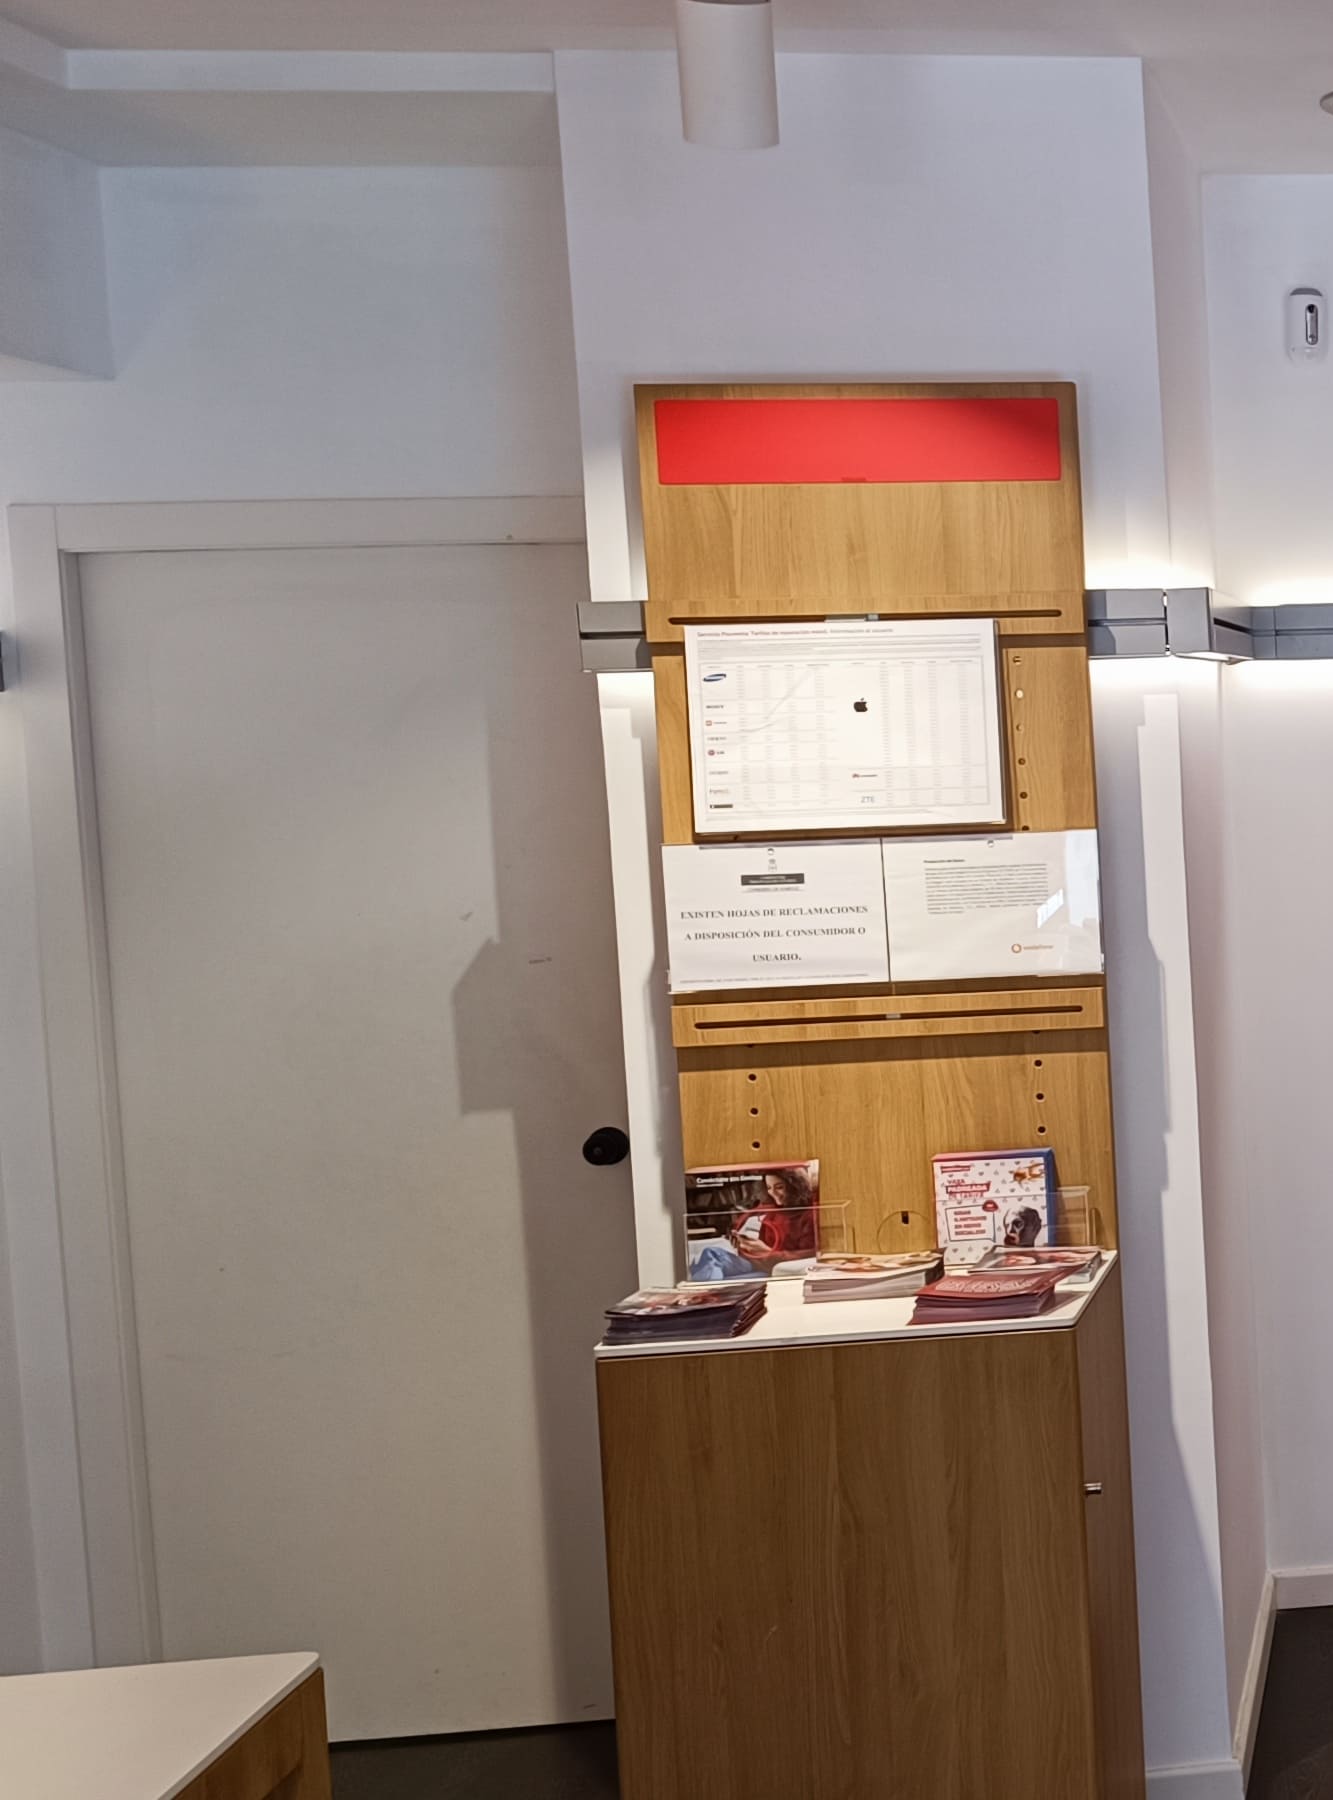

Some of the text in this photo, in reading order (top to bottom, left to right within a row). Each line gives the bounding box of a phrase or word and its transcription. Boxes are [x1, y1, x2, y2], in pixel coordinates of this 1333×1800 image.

[680, 905, 869, 920] EXISTEN HOJAS DE RECLAMACIONES
[684, 926, 866, 942] A DISPOSICIÓN DEL CONSUMIDOR O
[752, 952, 802, 963] USUARIO.
